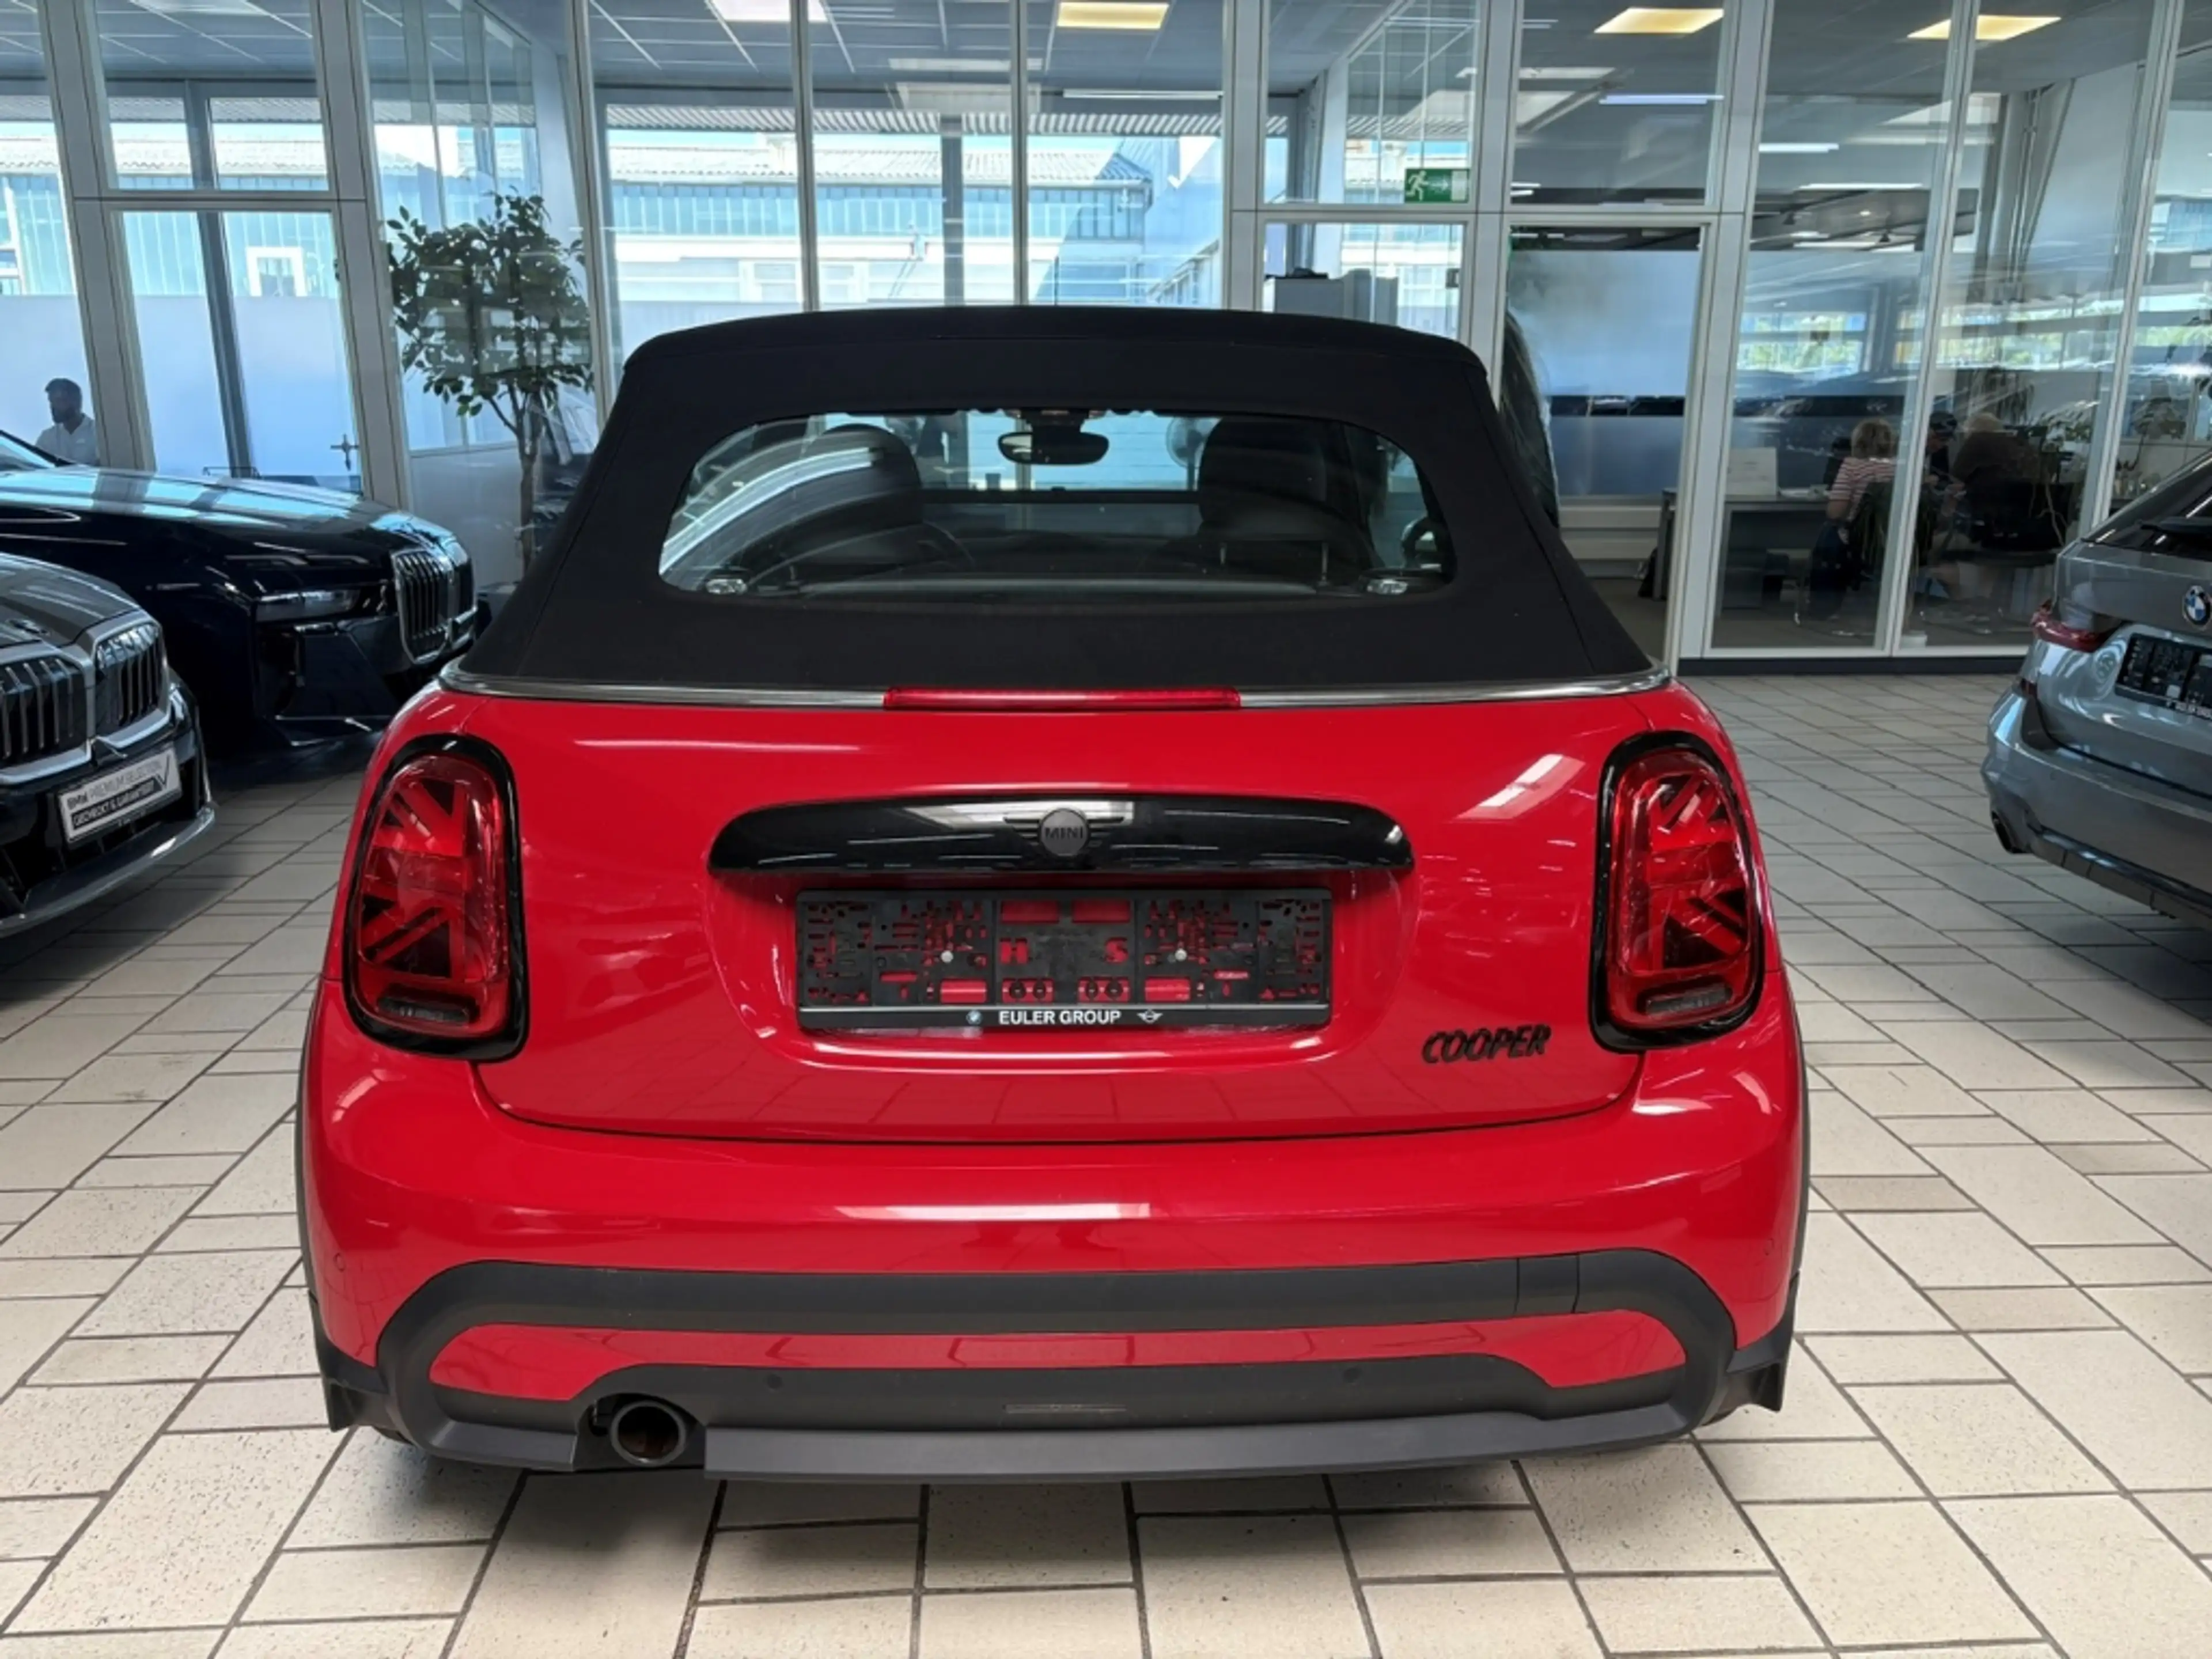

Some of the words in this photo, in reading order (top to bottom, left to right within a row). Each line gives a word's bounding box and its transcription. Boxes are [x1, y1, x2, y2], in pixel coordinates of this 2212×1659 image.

[1045, 826, 1083, 839] MINI
[999, 1010, 1056, 1025] EULER
[1059, 1009, 1122, 1025] GROUP
[1422, 1023, 1552, 1064] COOPER
